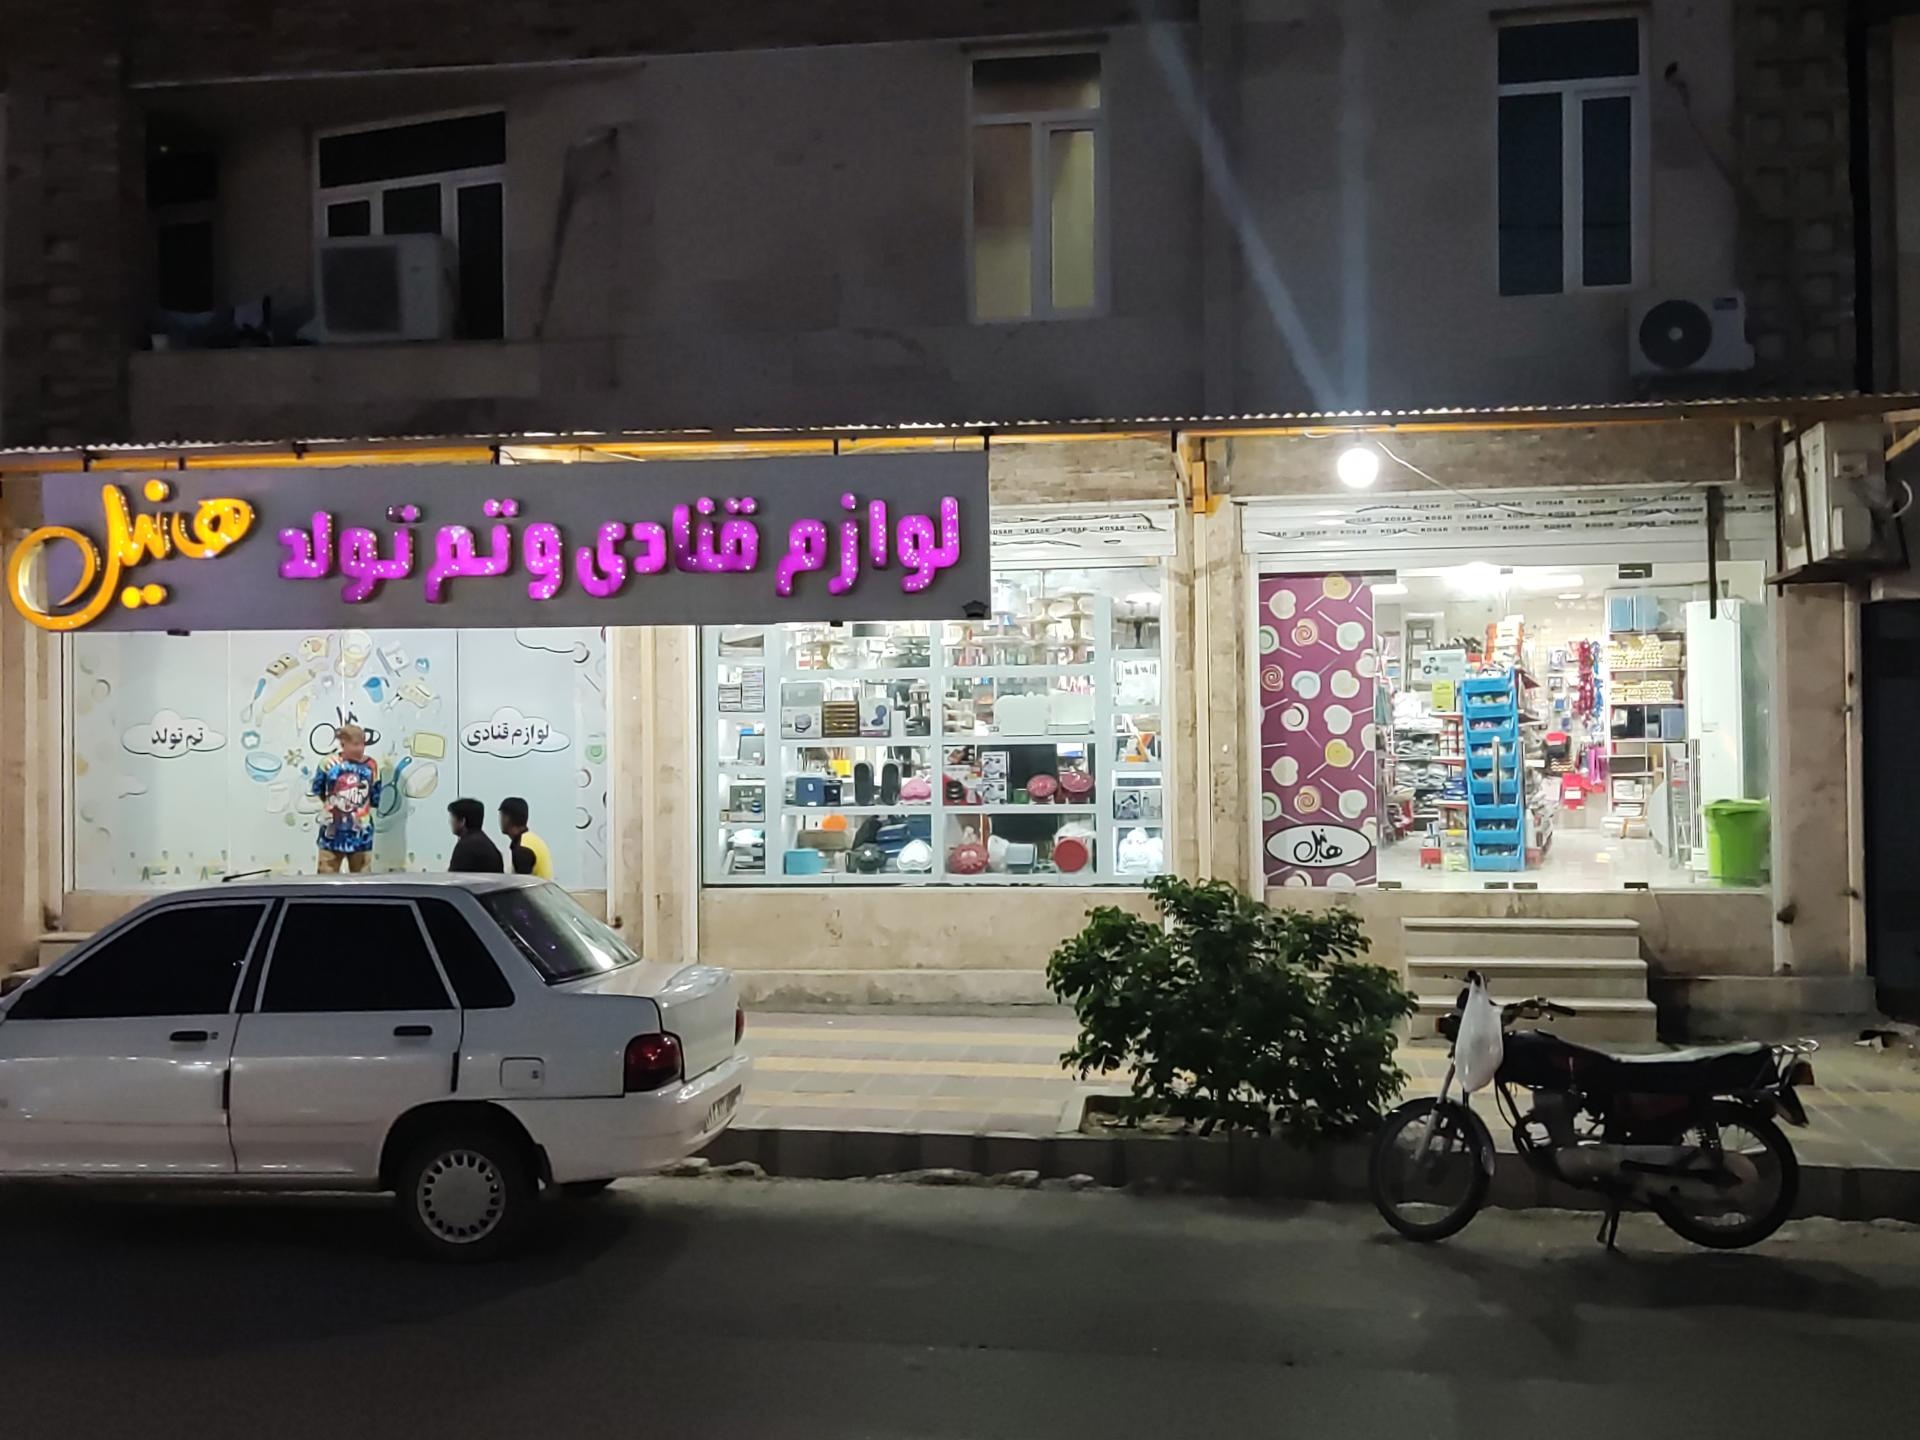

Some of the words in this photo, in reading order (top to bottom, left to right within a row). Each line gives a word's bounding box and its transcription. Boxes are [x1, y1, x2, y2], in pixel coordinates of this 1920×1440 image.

[278, 505, 422, 603] تولد
[424, 498, 519, 603] تم
[522, 521, 564, 600] و
[575, 496, 760, 599] قنادی
[775, 490, 959, 597] لوازم
[151, 727, 183, 750] تولد
[185, 726, 204, 750] تم
[466, 722, 509, 747] قنادی
[511, 723, 549, 746] لوازم
